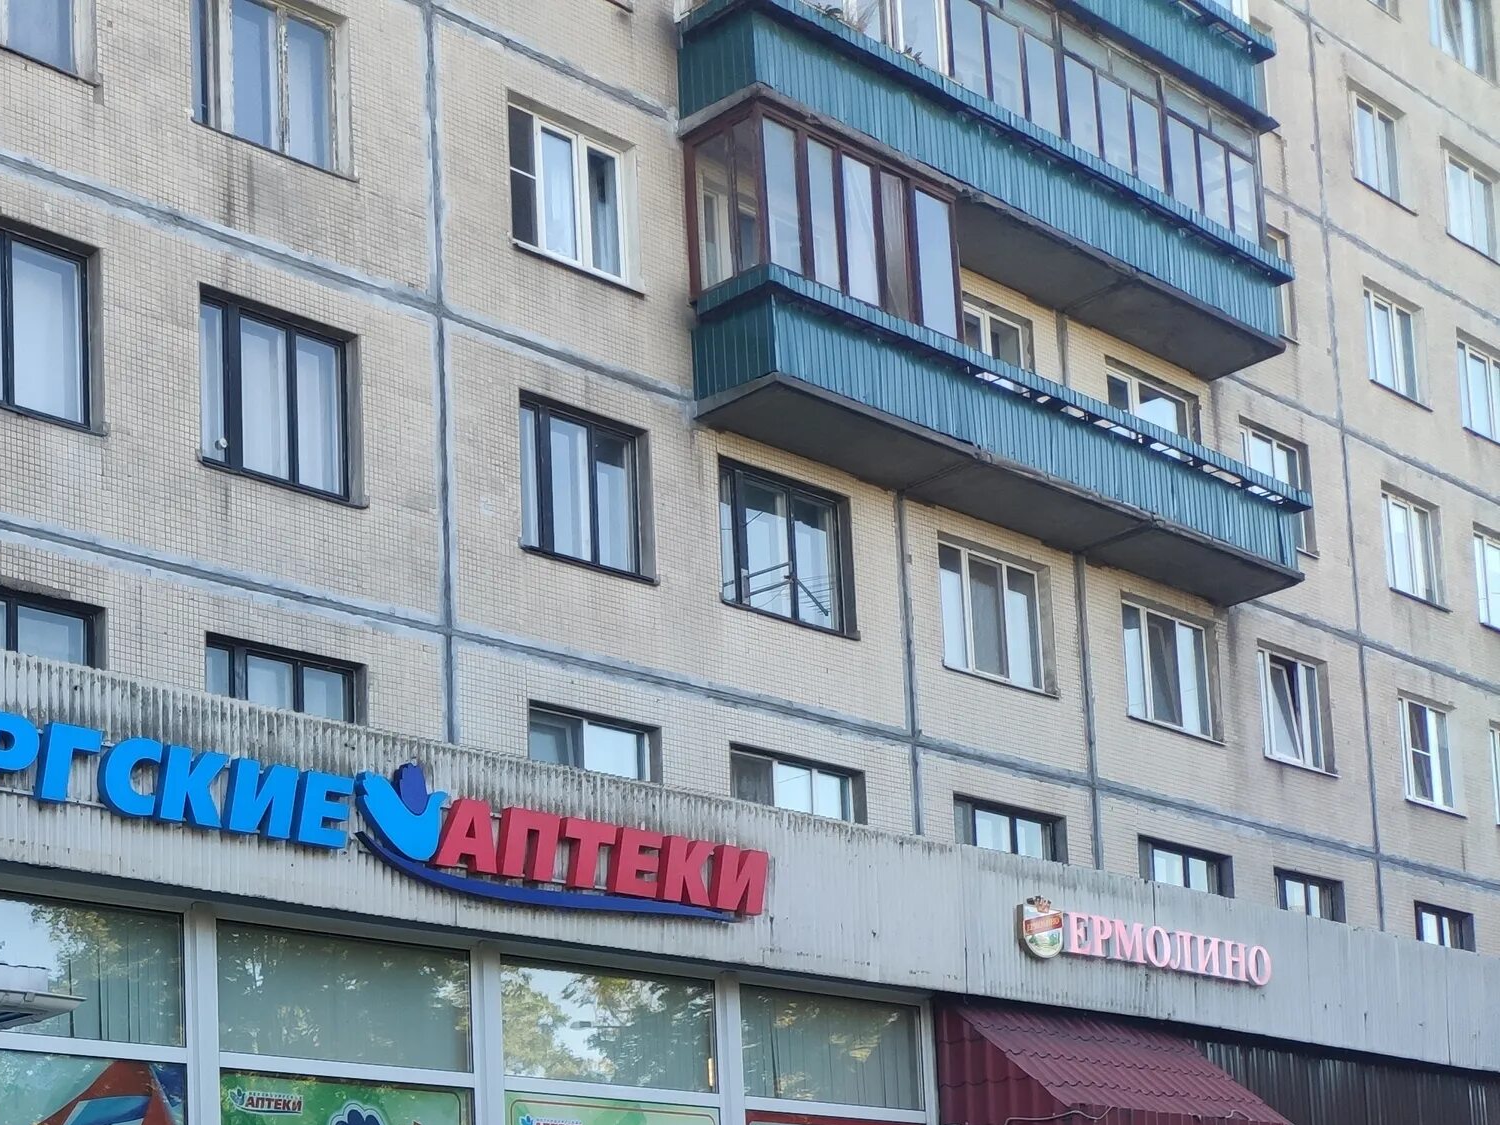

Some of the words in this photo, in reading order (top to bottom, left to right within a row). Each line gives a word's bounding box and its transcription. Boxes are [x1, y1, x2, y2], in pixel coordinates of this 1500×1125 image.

[431, 798, 768, 916] АПТЕКИ
[1064, 911, 1272, 986] ЕРМОЛИНО
[245, 1096, 303, 1112] АПТЕКИ
